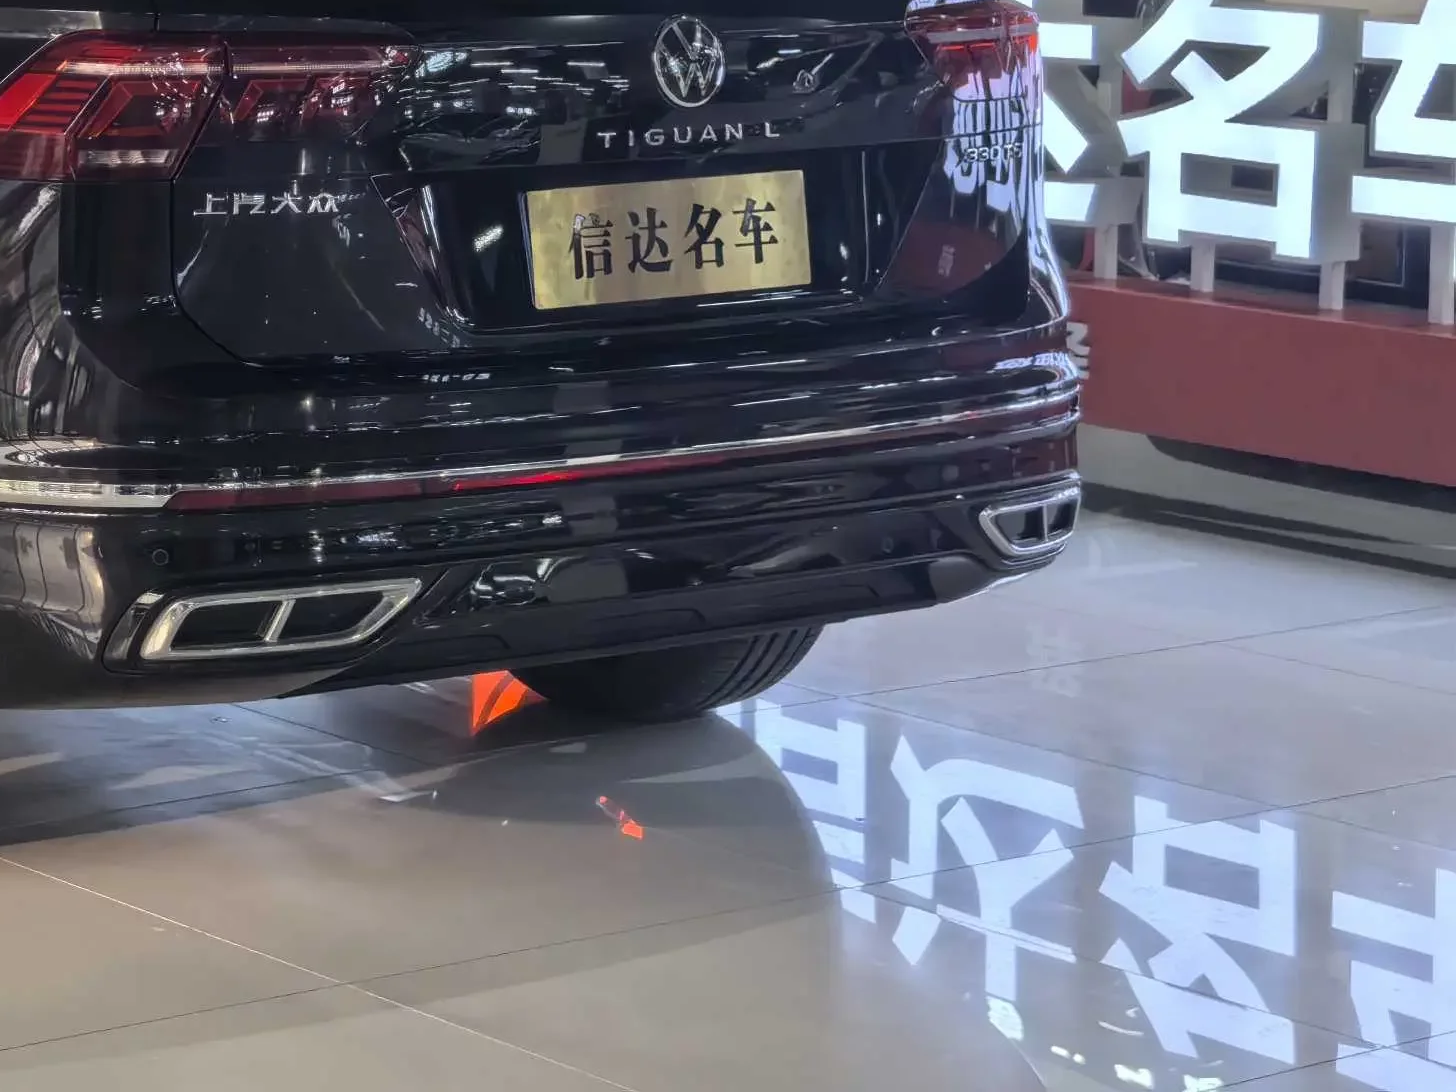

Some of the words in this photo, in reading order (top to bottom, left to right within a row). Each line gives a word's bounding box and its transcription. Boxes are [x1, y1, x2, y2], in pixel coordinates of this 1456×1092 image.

[597, 122, 744, 149] TIGUAN
[764, 121, 781, 138] L
[193, 192, 340, 215] 上汽大众
[568, 199, 780, 281] 信达名车
